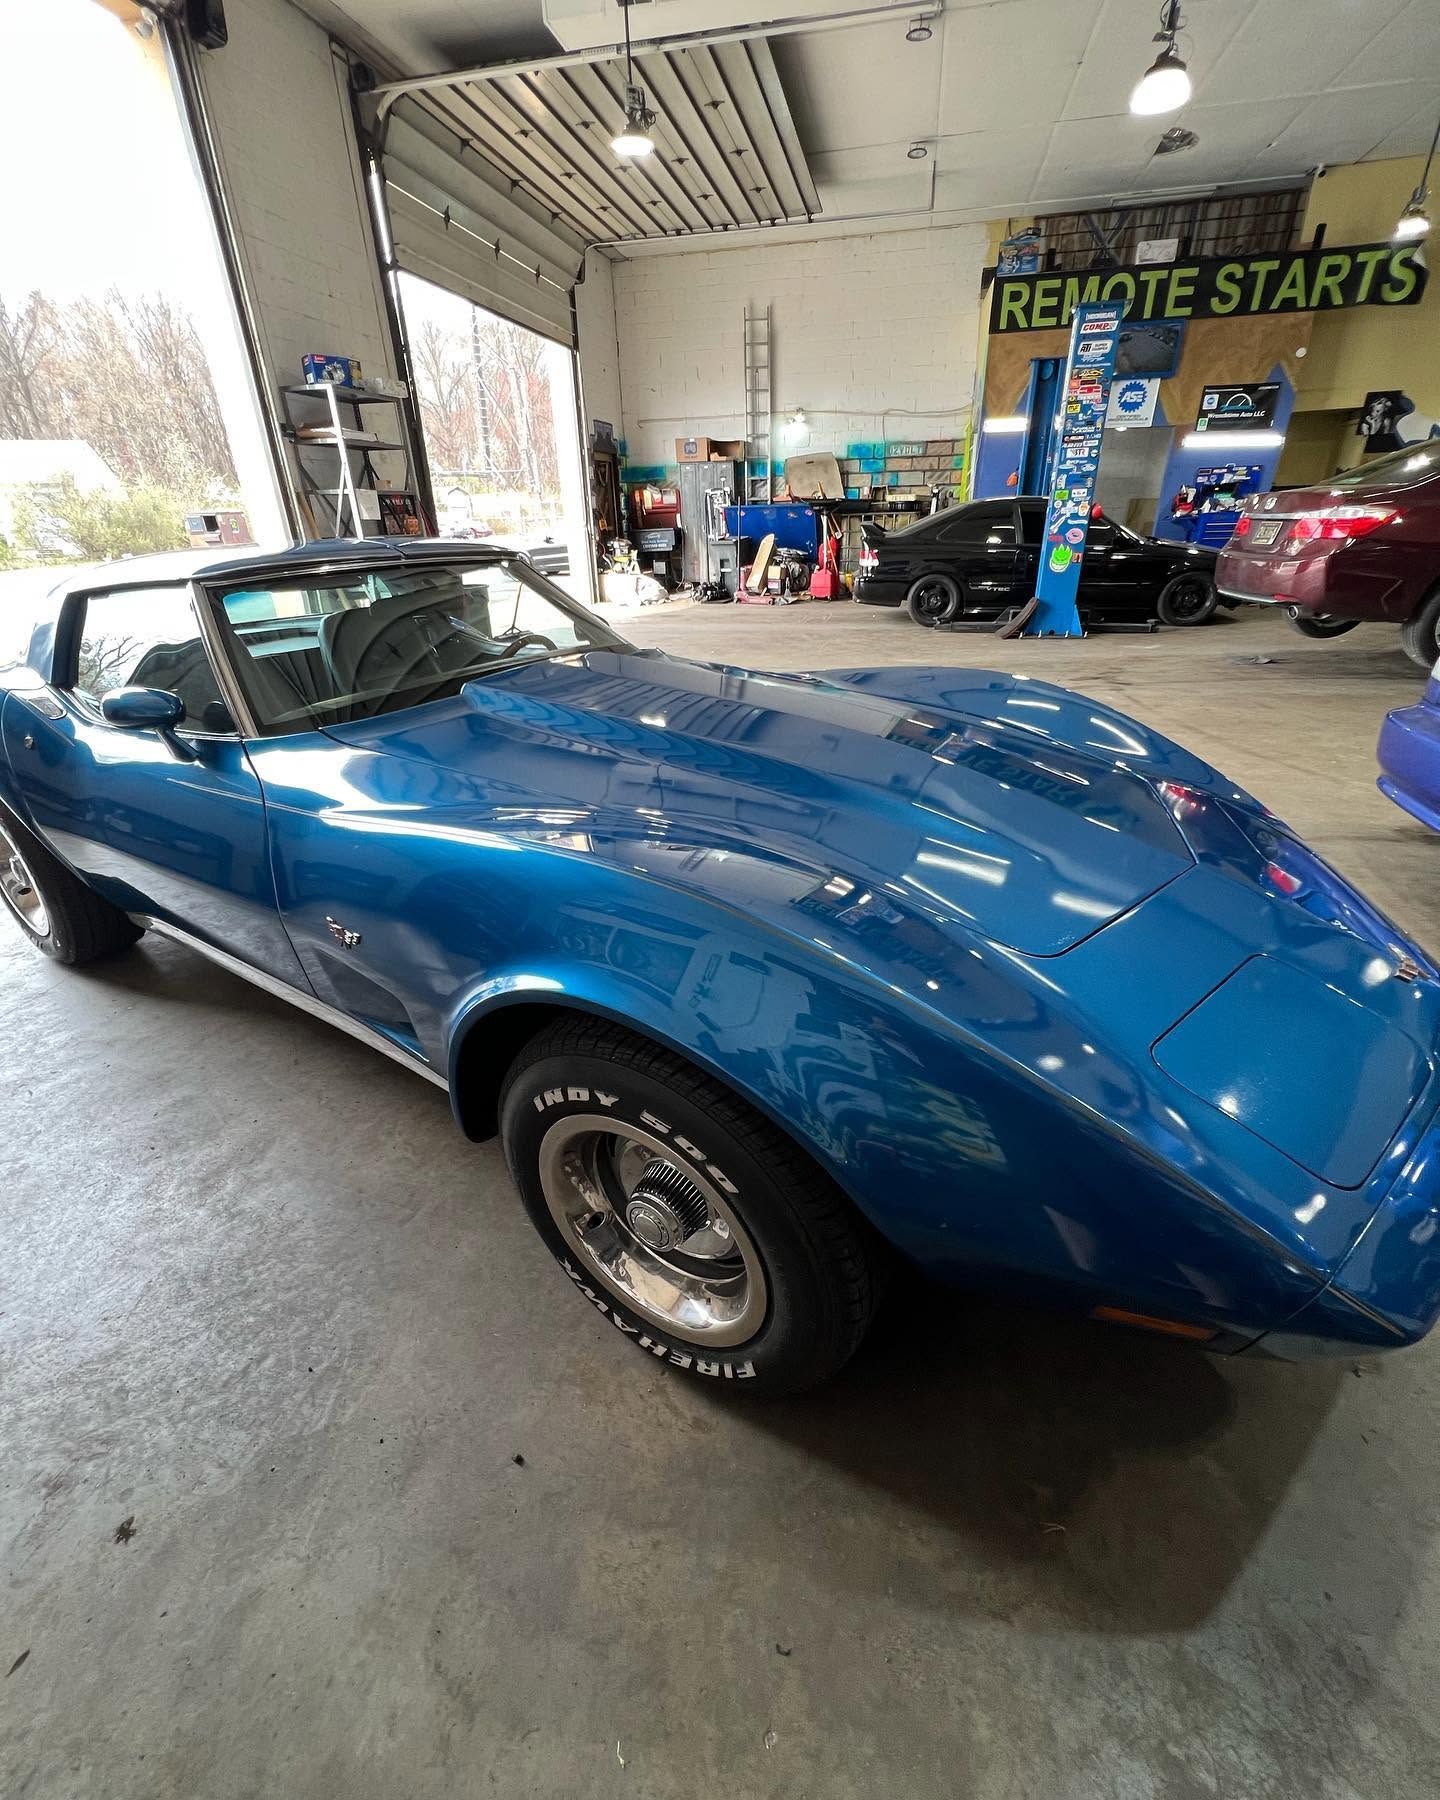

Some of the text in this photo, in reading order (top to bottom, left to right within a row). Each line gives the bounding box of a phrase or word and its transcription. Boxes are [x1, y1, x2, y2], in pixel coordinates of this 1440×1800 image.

[999, 247, 1418, 330] REMOTE STARTS
[1082, 322, 1110, 332] COMP
[1120, 391, 1145, 403] ASE
[533, 1086, 740, 1194] INDY 500
[556, 1256, 757, 1379] FIREHAWK
